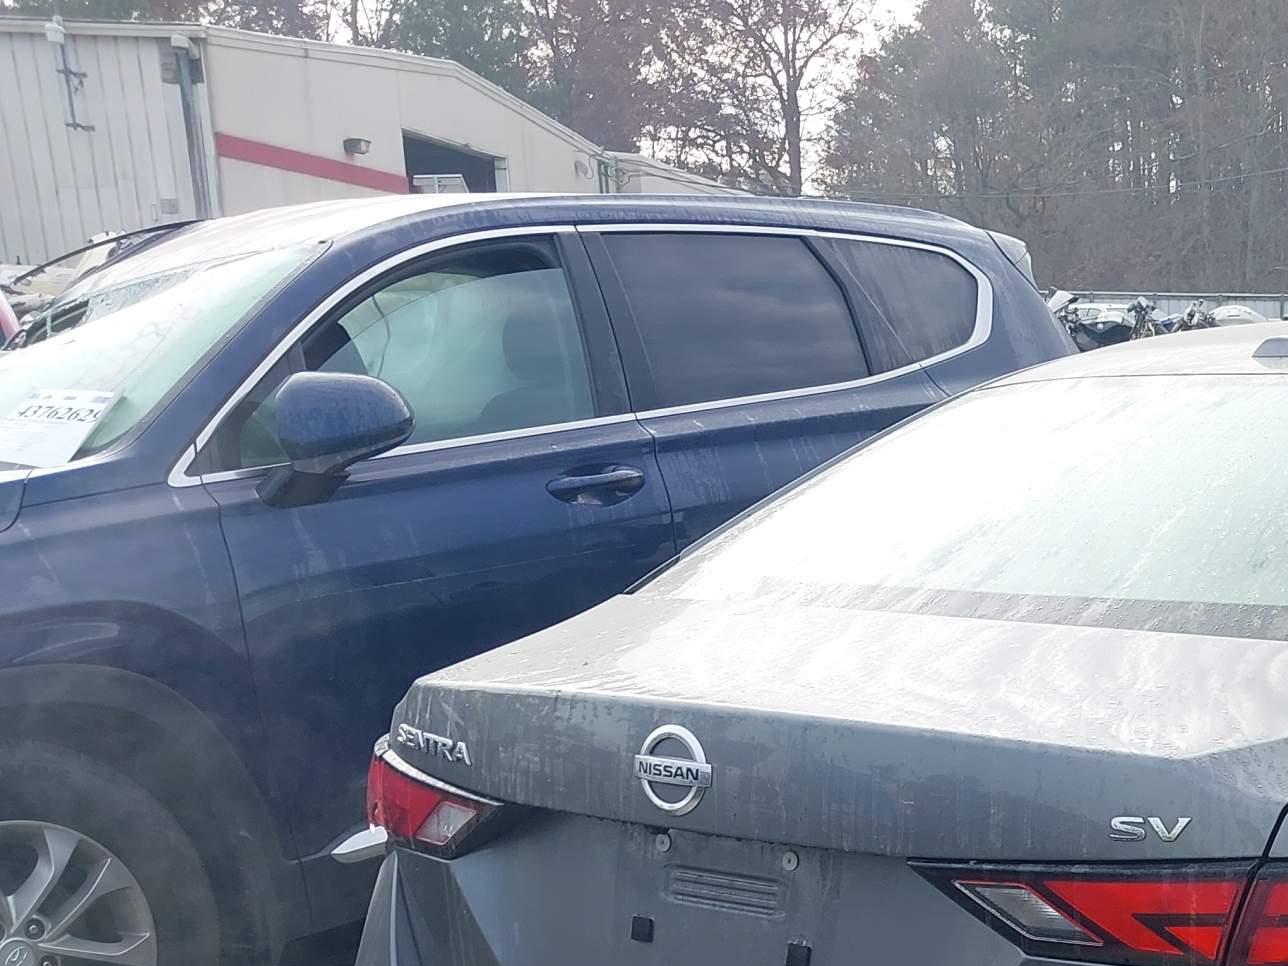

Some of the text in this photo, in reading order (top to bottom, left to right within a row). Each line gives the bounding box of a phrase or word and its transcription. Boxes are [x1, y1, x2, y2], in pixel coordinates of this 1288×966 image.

[397, 723, 471, 766] SENTRA
[638, 760, 700, 781] NISSAN
[1109, 816, 1193, 842] SV
